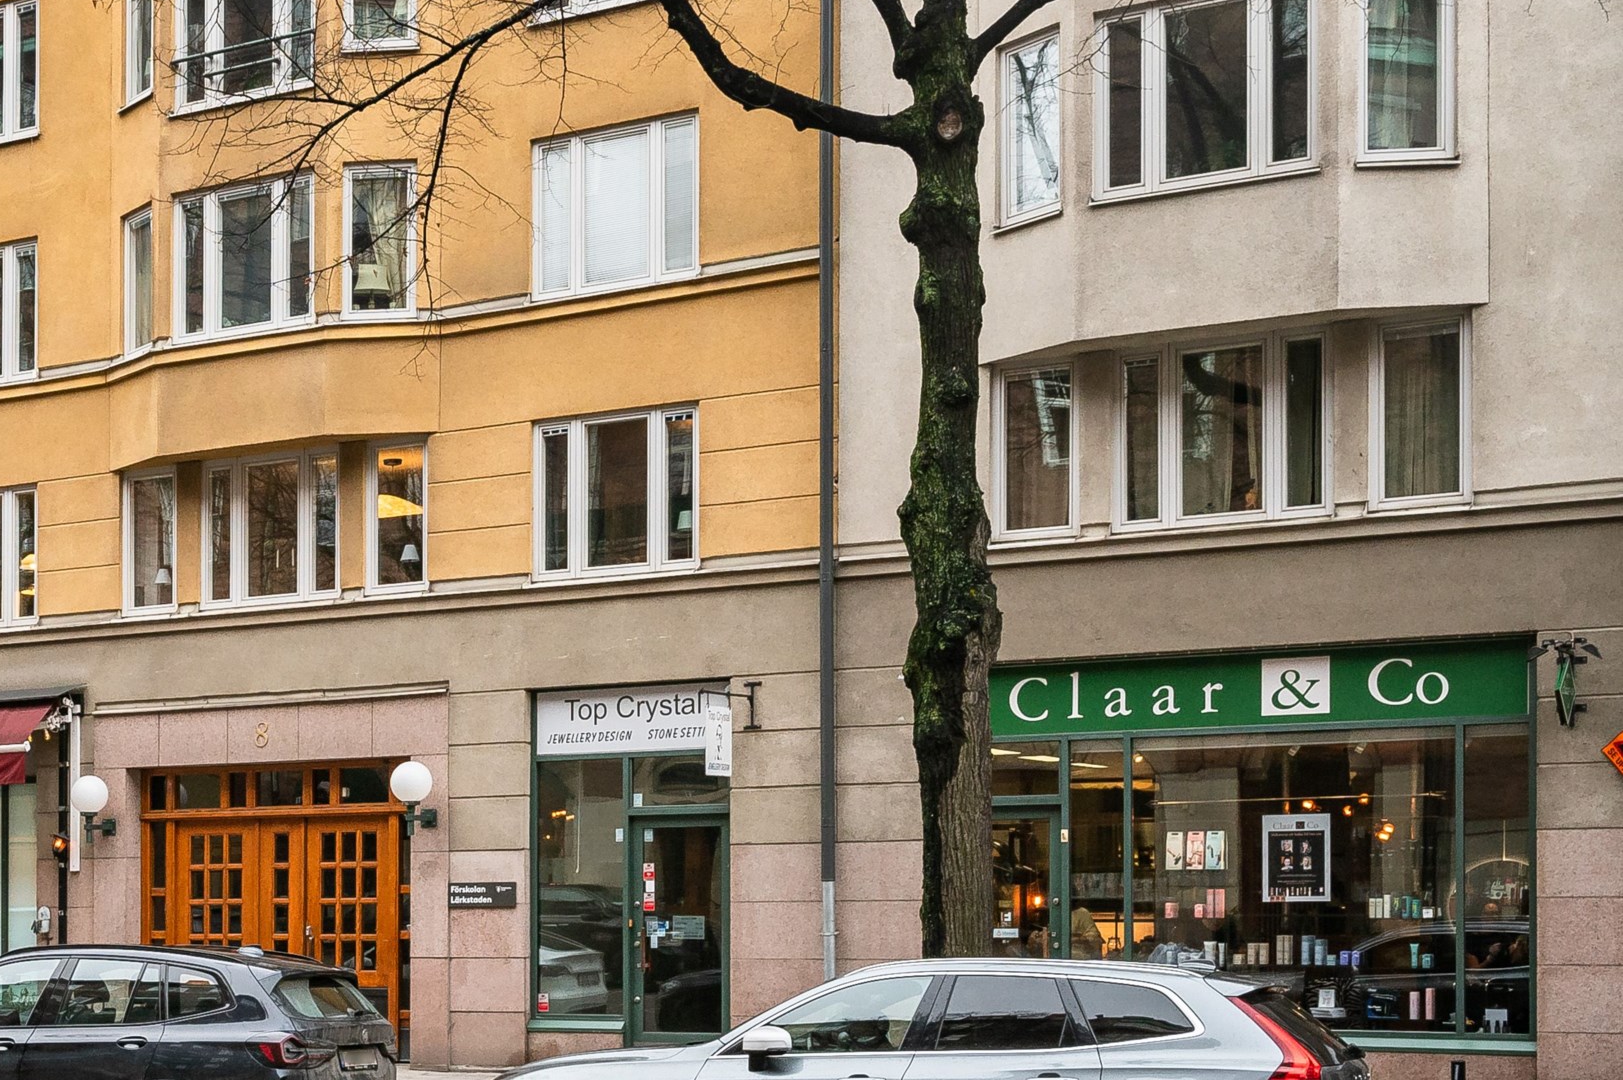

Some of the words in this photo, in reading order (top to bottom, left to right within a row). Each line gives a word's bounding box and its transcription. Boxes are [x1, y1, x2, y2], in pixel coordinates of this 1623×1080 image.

[1008, 671, 1224, 722] Claar
[1271, 669, 1321, 710] &
[1367, 657, 1450, 707] Co
[564, 699, 607, 726] Top
[616, 693, 702, 723] Crystal
[255, 722, 269, 748] 8
[547, 731, 598, 745] JEWELLERY
[598, 730, 633, 743] DESIGN
[647, 728, 679, 740] STONE
[679, 726, 706, 739] SETTI
[450, 885, 486, 893] Förskolan
[450, 895, 493, 904] Lärkstaden
